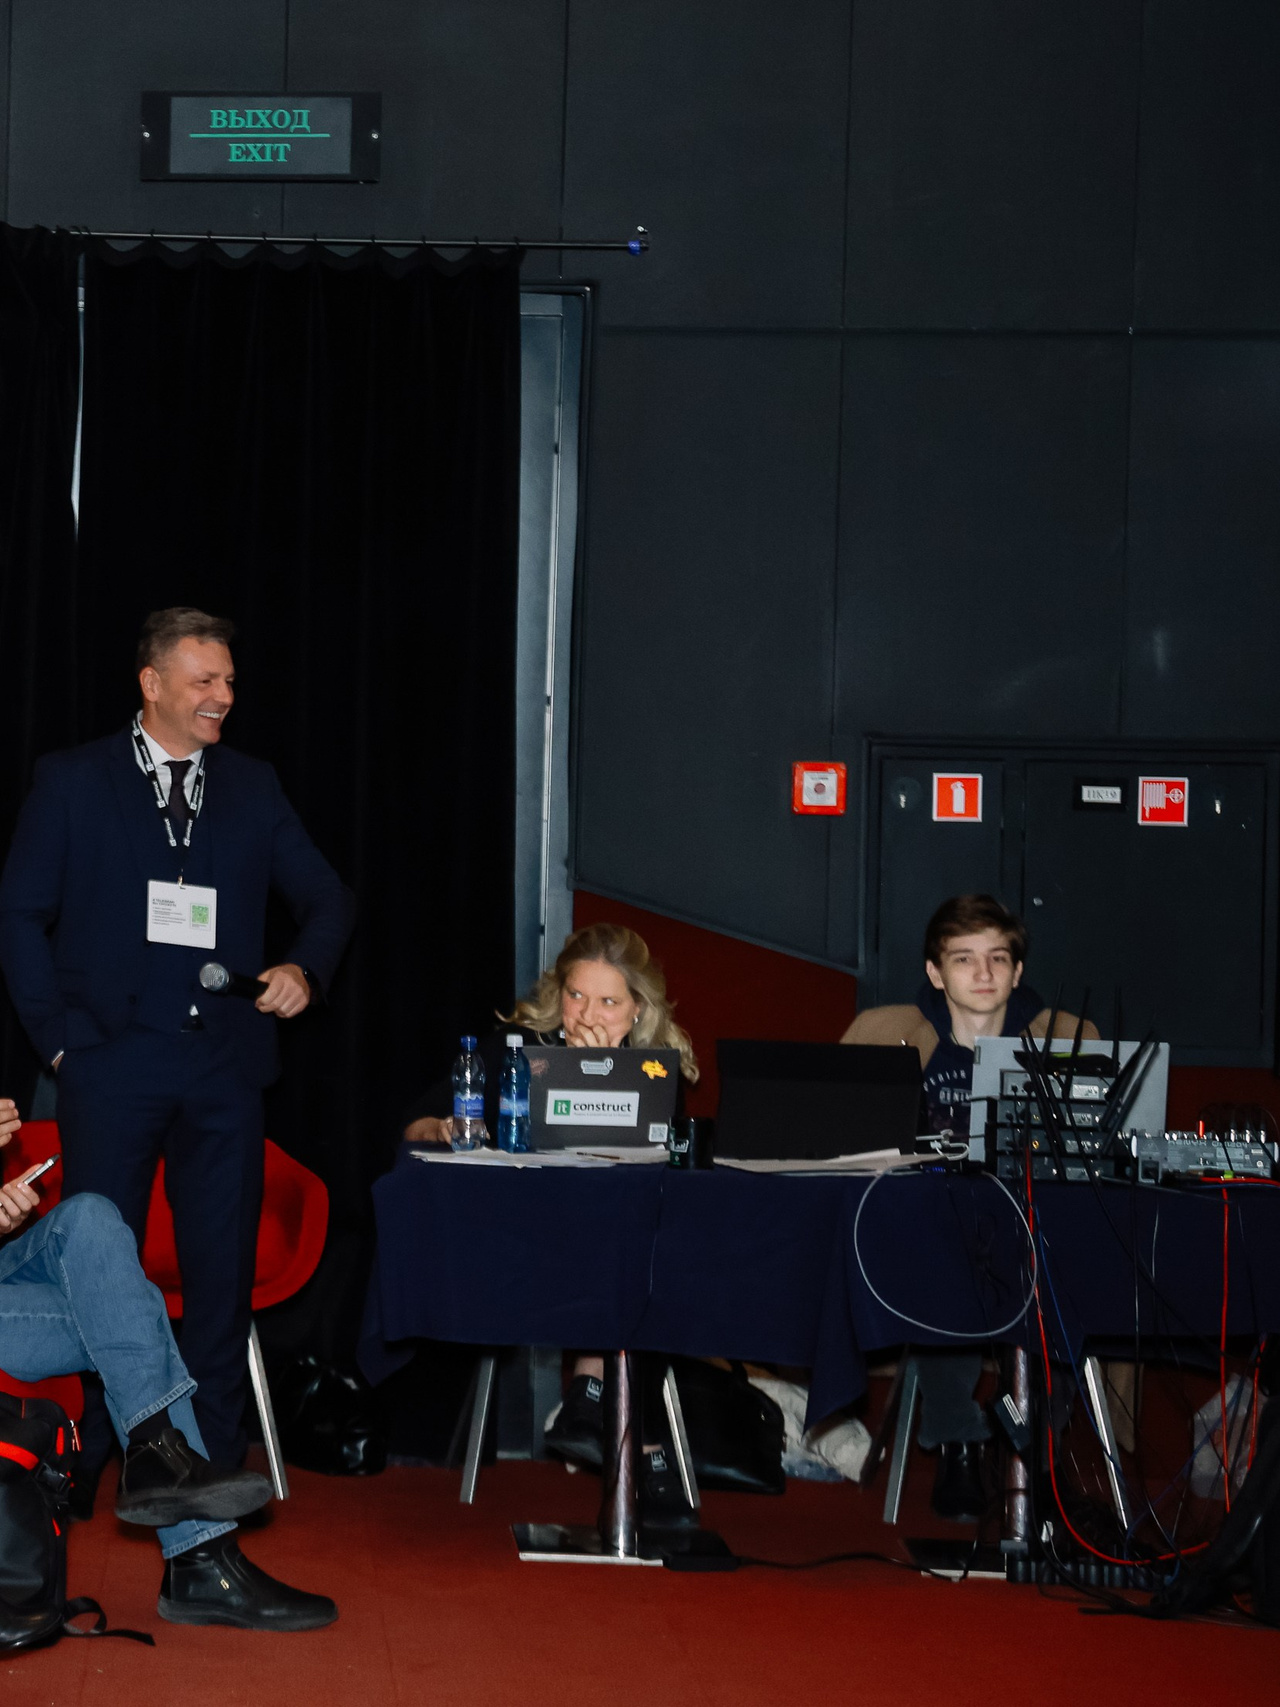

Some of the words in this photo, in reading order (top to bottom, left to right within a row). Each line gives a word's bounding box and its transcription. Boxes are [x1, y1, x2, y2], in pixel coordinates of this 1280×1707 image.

[209, 109, 311, 133] ВЫХОД
[228, 143, 291, 163] EXIT
[557, 1101, 568, 1114] it
[573, 1102, 632, 1113] construct
